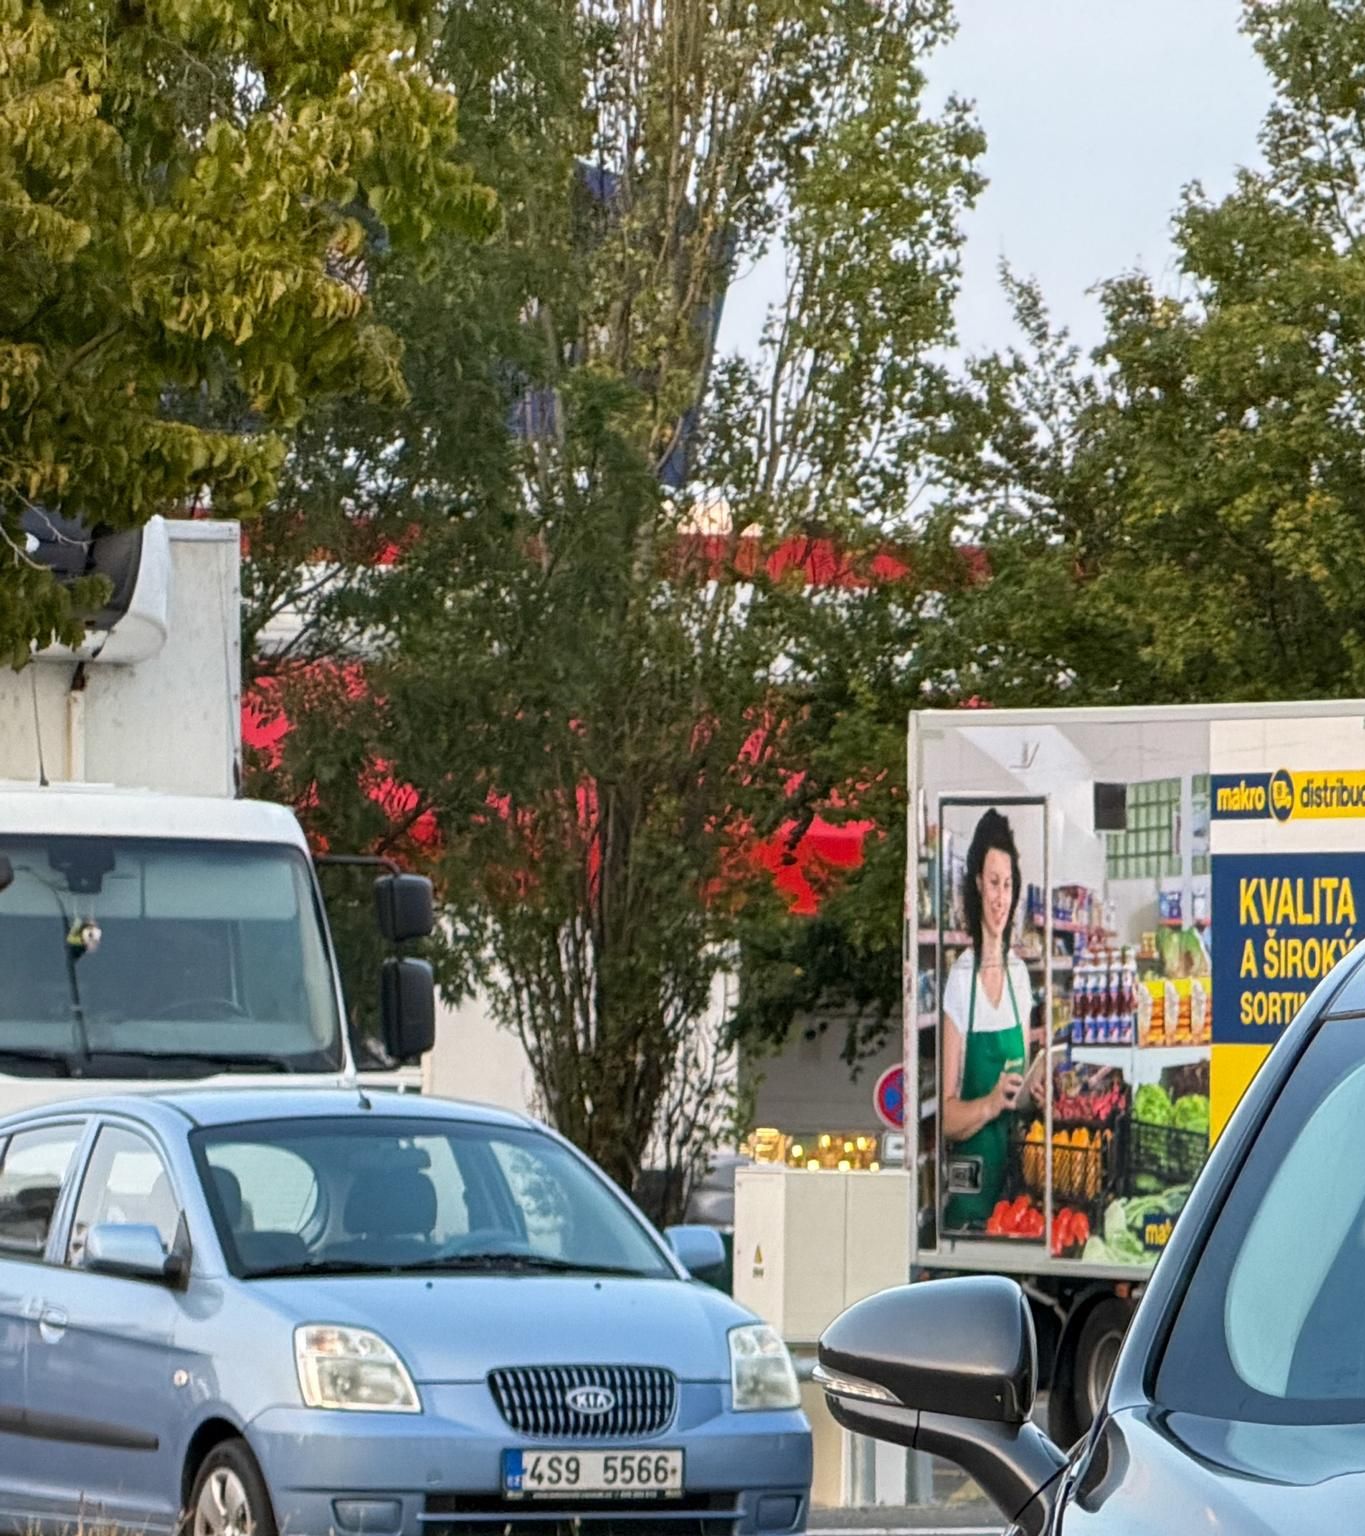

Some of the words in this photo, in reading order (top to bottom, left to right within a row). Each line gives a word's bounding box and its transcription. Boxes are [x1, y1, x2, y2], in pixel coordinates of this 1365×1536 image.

[1216, 780, 1265, 811] makro
[1239, 877, 1357, 925] KVALITA
[1239, 938, 1258, 978] A
[576, 1393, 608, 1408] KIA
[529, 1455, 580, 1485] 4S9
[603, 1455, 669, 1485] 5566
